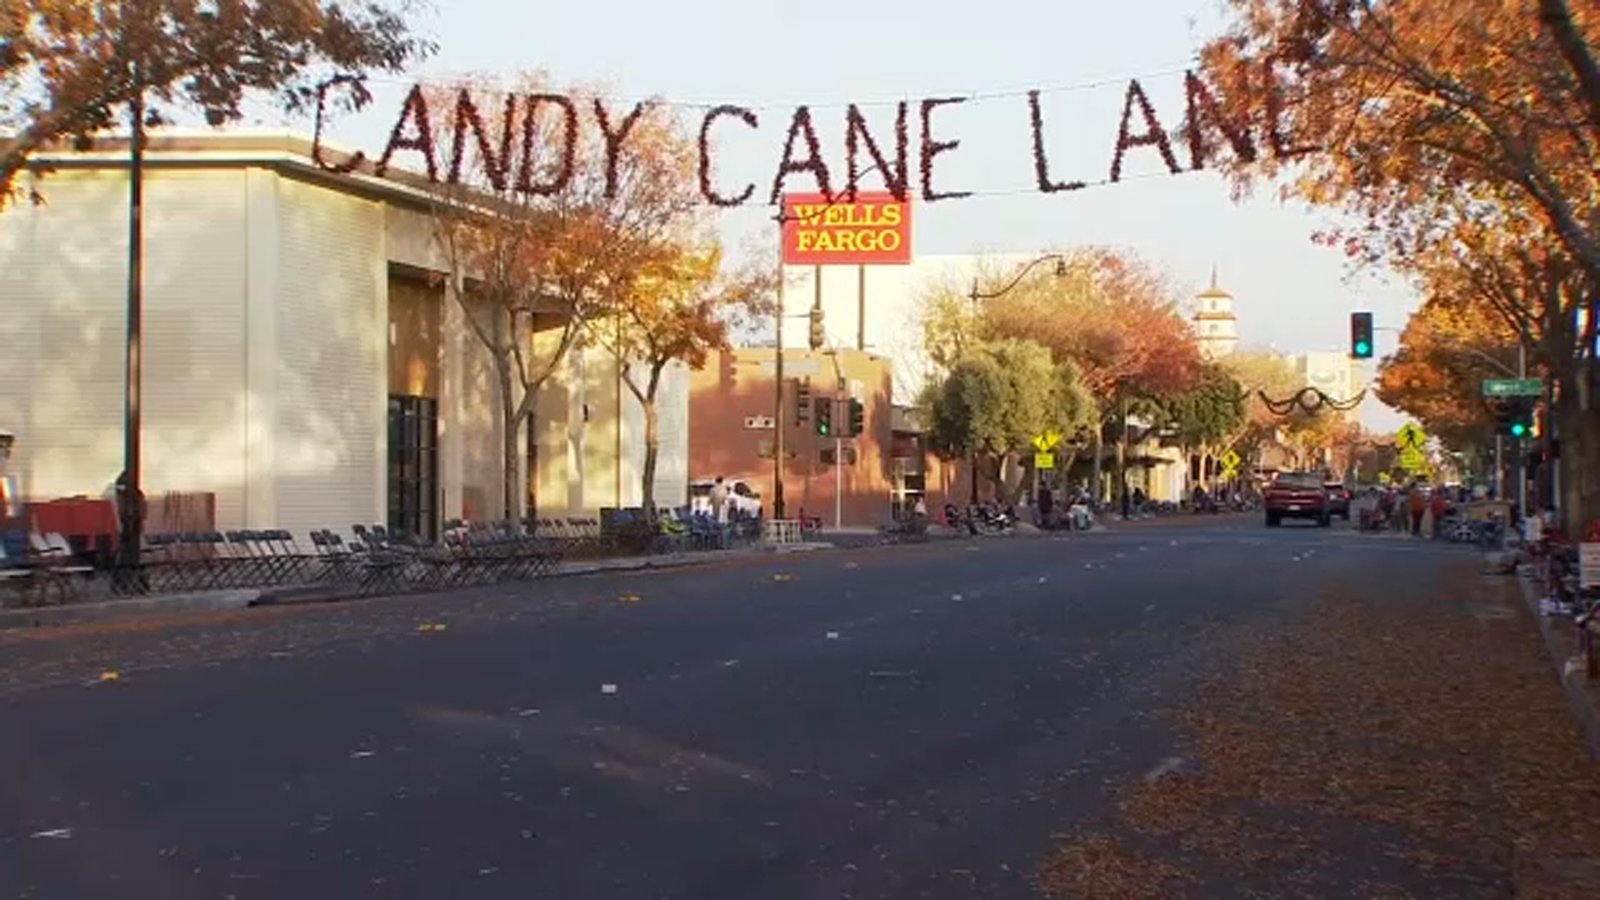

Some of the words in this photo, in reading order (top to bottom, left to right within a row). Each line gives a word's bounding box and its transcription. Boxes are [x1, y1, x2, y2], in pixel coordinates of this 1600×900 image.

[311, 74, 648, 201] CANDY
[698, 97, 974, 206] CANE
[793, 203, 901, 227] WELLS
[796, 229, 901, 251] FARGO
